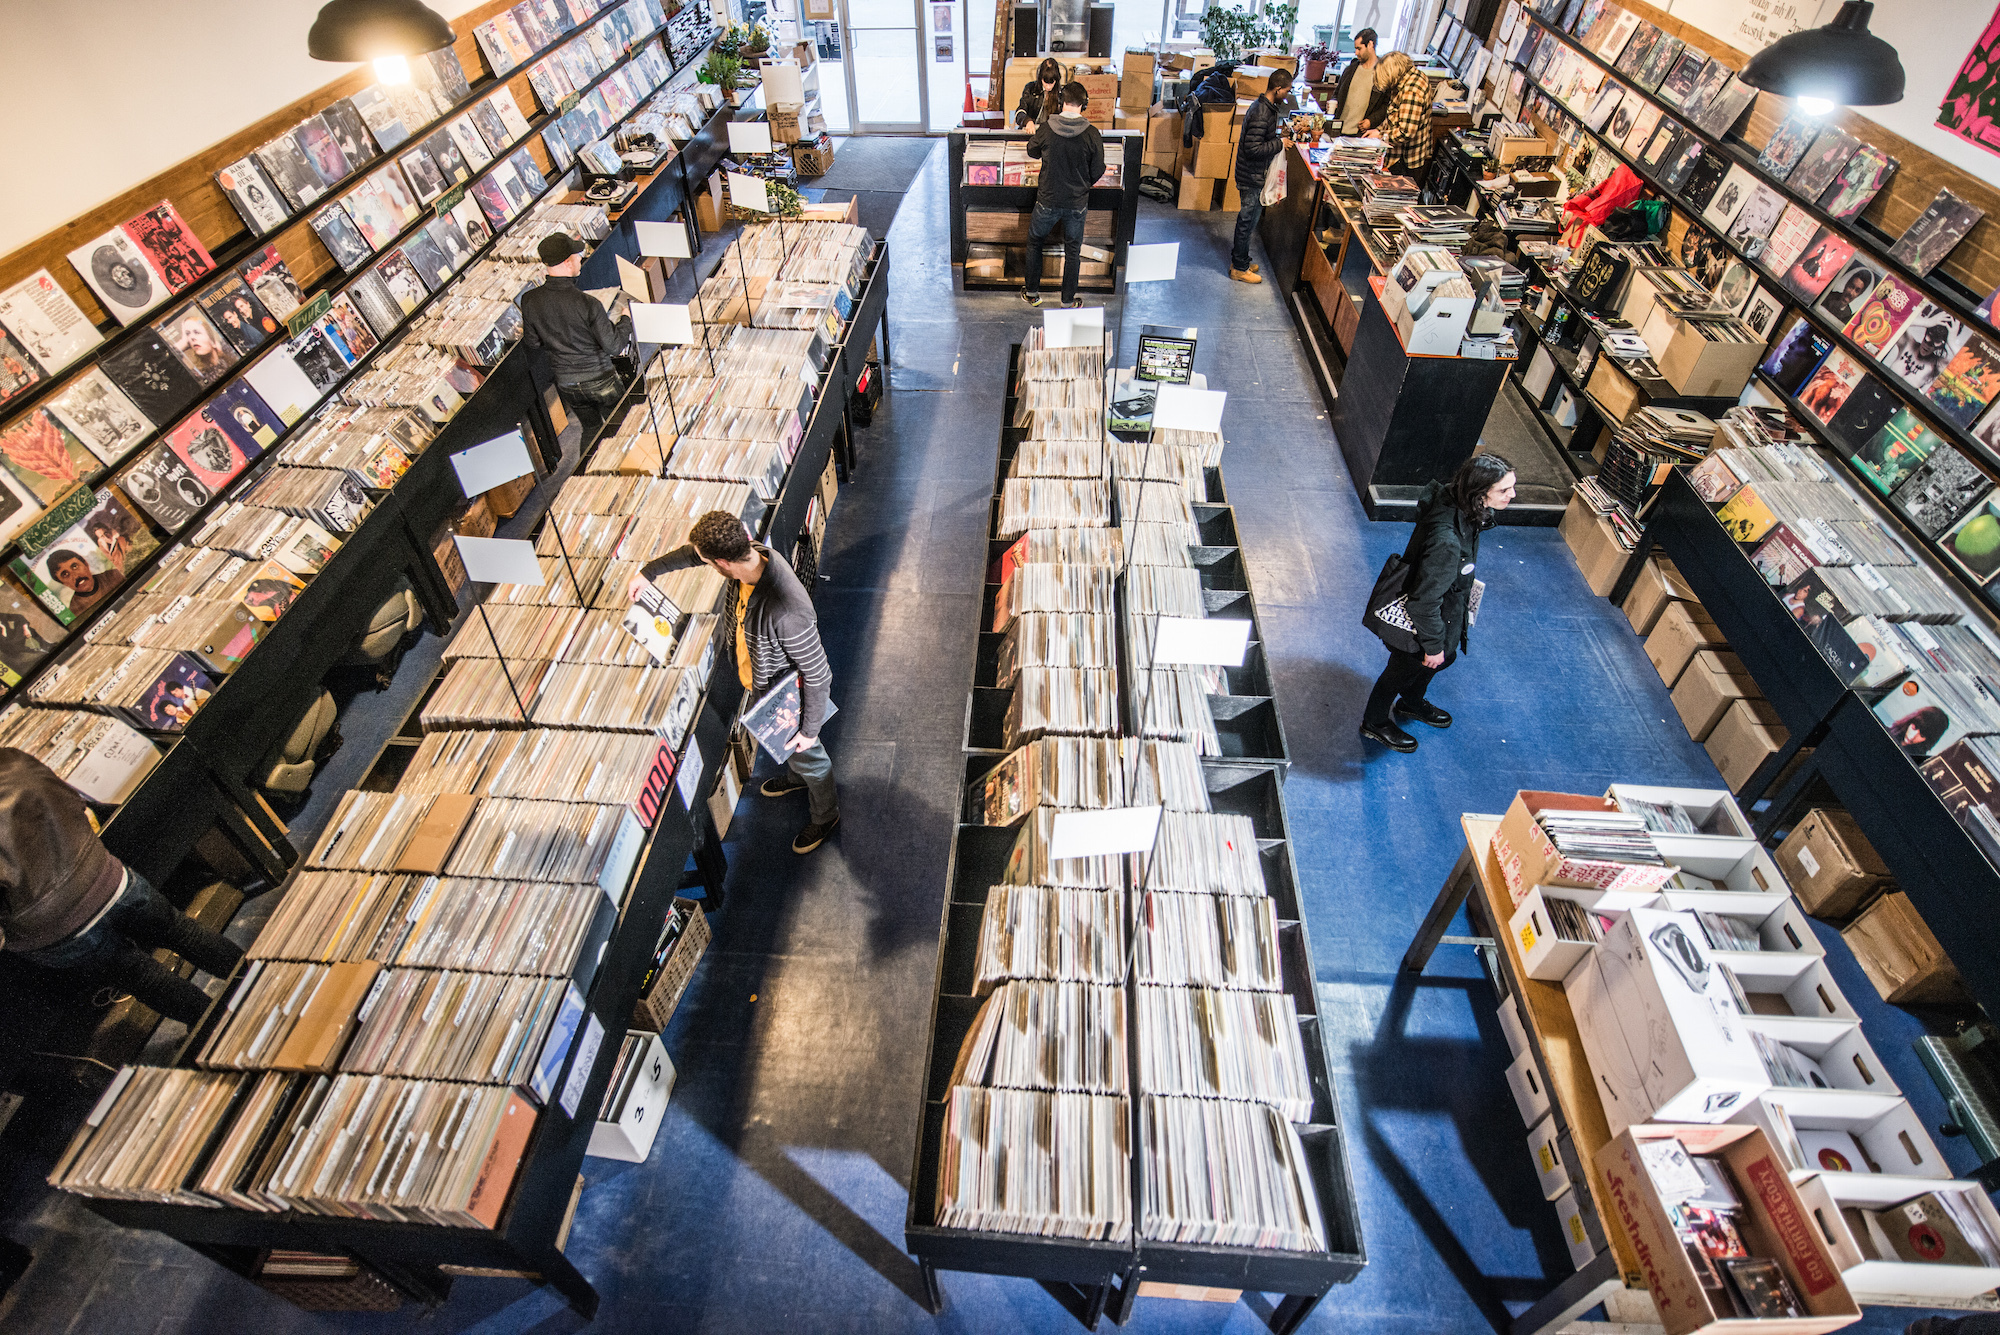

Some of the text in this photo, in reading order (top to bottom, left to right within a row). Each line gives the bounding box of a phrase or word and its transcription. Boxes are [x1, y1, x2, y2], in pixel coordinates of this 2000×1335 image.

[1087, 87, 1111, 95] eshdirect
[229, 162, 246, 174] KING
[237, 174, 254, 187] PUNK
[139, 461, 156, 474] SIX
[154, 460, 170, 479] FEET
[166, 463, 187, 482] UNDER
[1790, 541, 1801, 556] THE
[1824, 642, 1844, 668] EAGLES
[620, 818, 633, 839] MEER
[1607, 1168, 1671, 1311] freshdirect
[1786, 1217, 1815, 1262] FORTH
